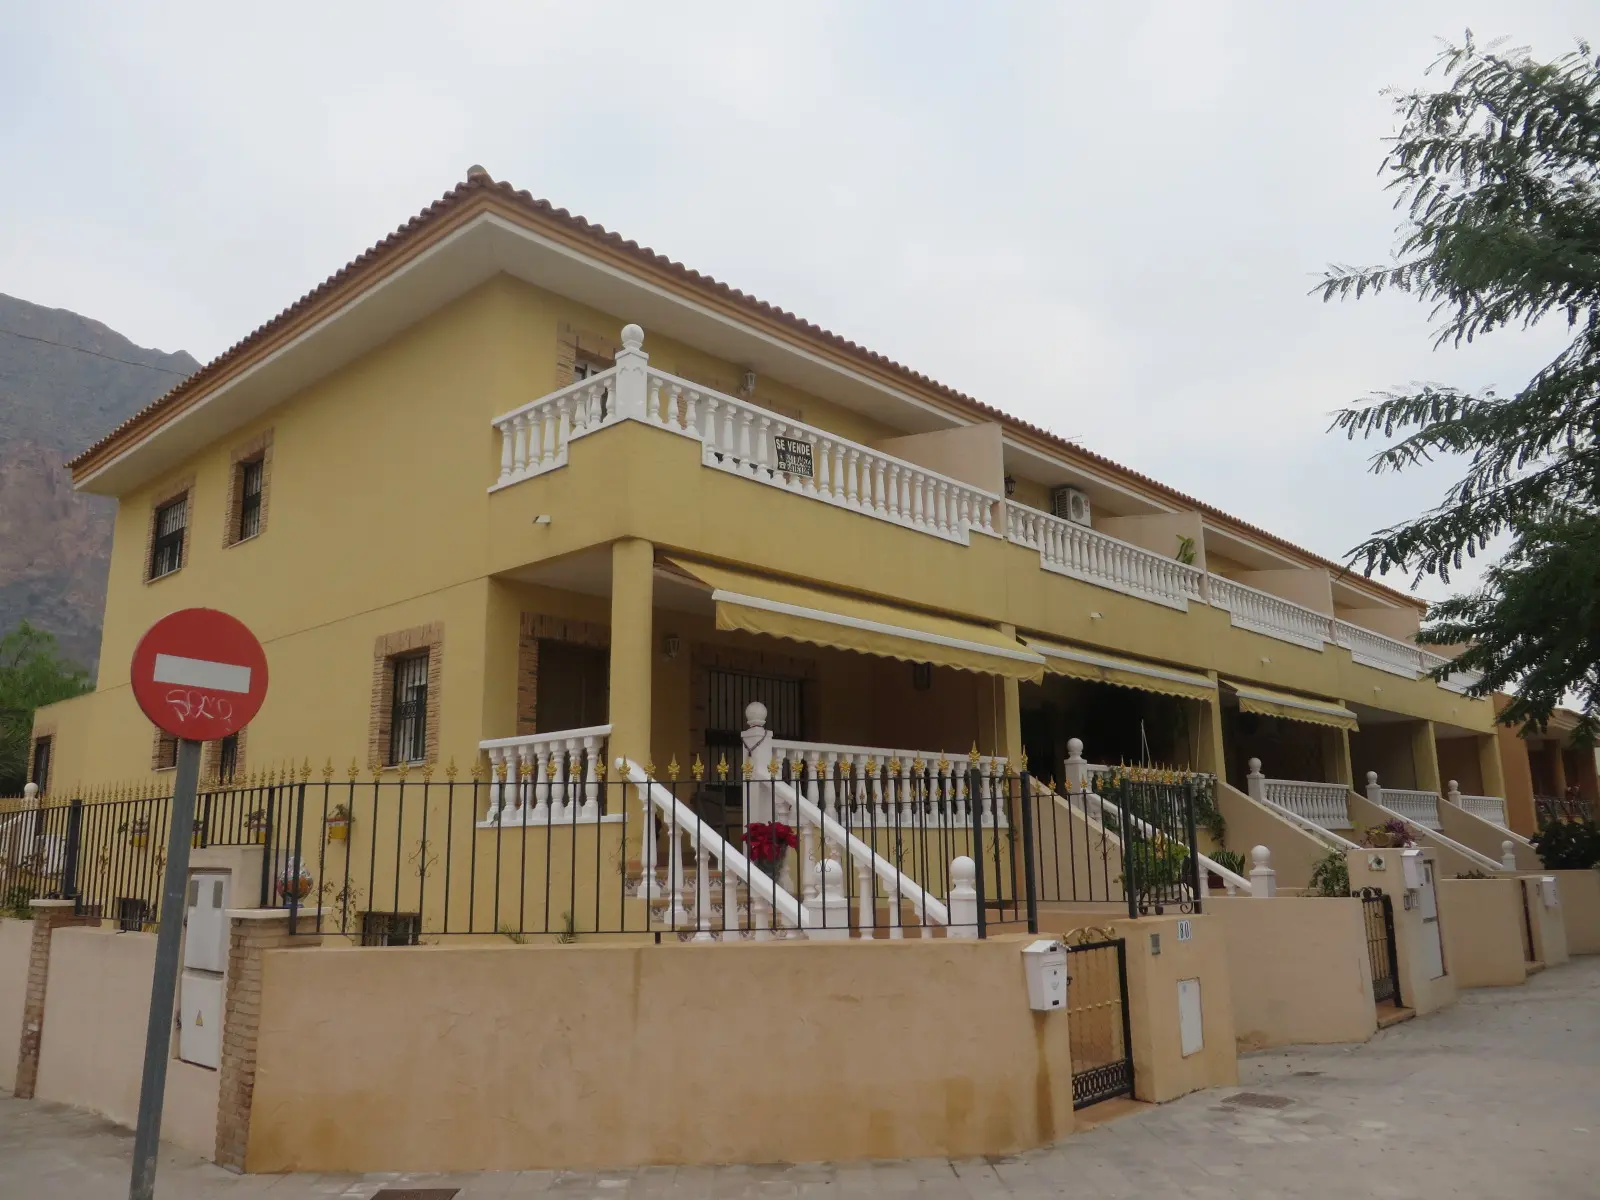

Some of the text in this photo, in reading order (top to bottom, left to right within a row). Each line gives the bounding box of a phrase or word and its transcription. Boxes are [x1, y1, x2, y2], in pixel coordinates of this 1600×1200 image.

[775, 438, 811, 456] SE VENDE
[1179, 921, 1190, 939] 80
